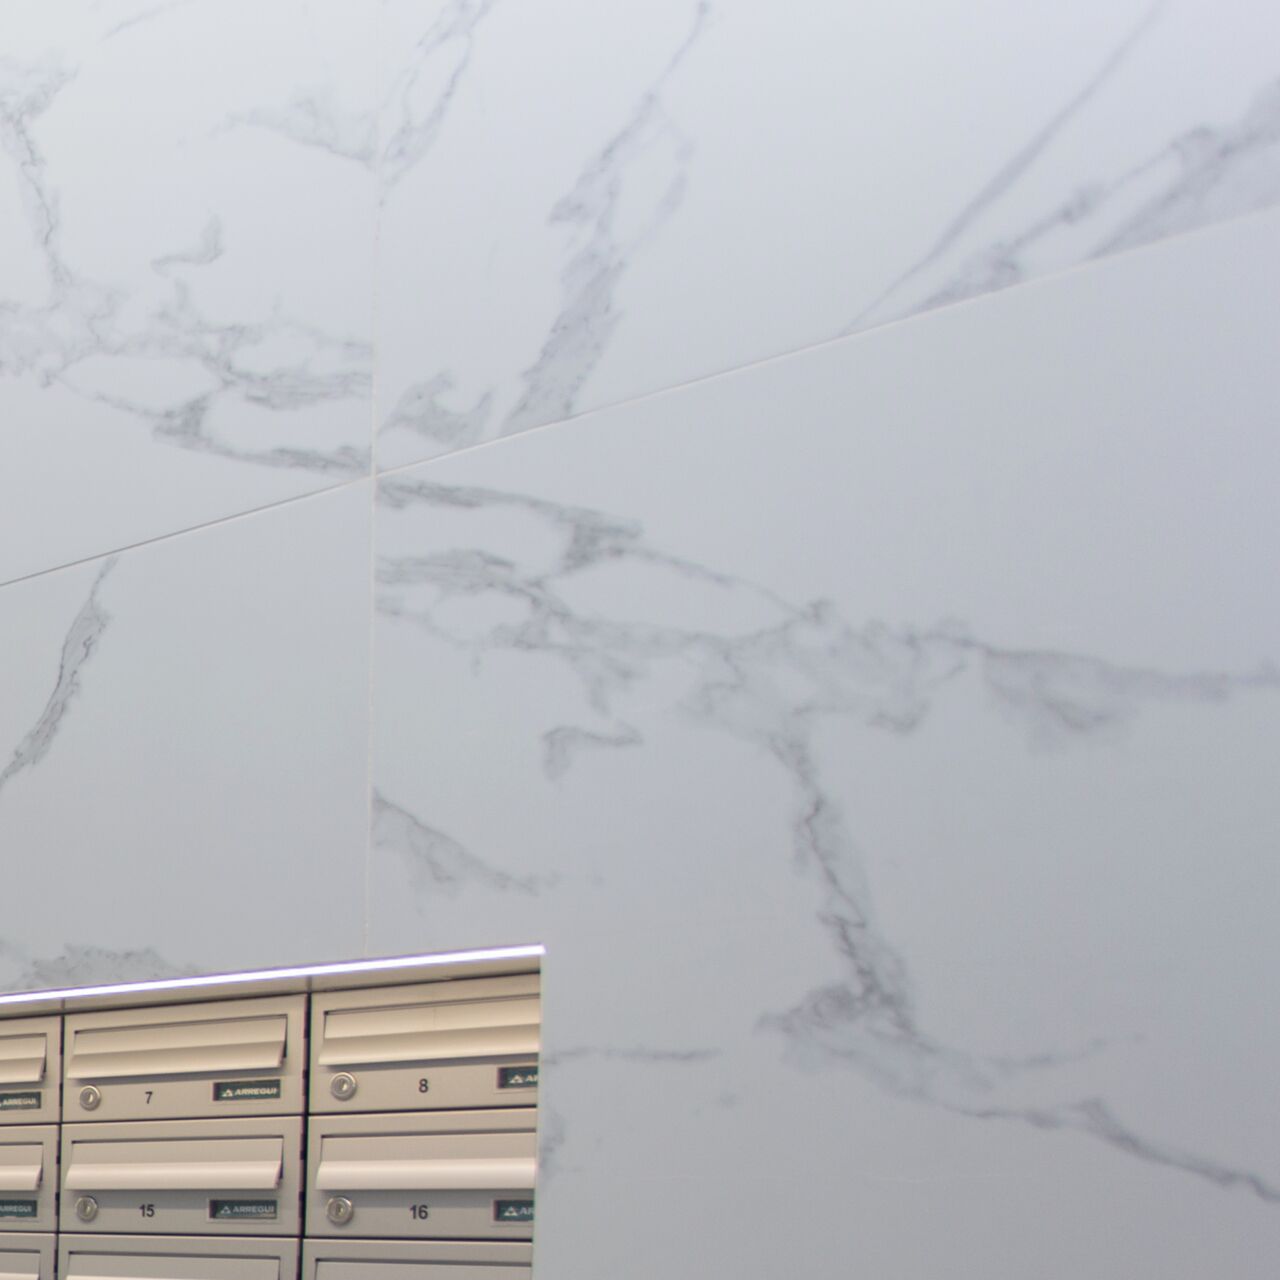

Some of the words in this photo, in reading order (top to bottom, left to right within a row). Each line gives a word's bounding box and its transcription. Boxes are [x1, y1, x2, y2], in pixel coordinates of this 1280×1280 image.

[234, 1087, 278, 1095] ARREGUI
[418, 1077, 430, 1094] 8
[144, 1090, 154, 1105] 7
[139, 1203, 156, 1218] 15
[232, 1206, 274, 1214] ARREGUI
[409, 1204, 429, 1221] 16
